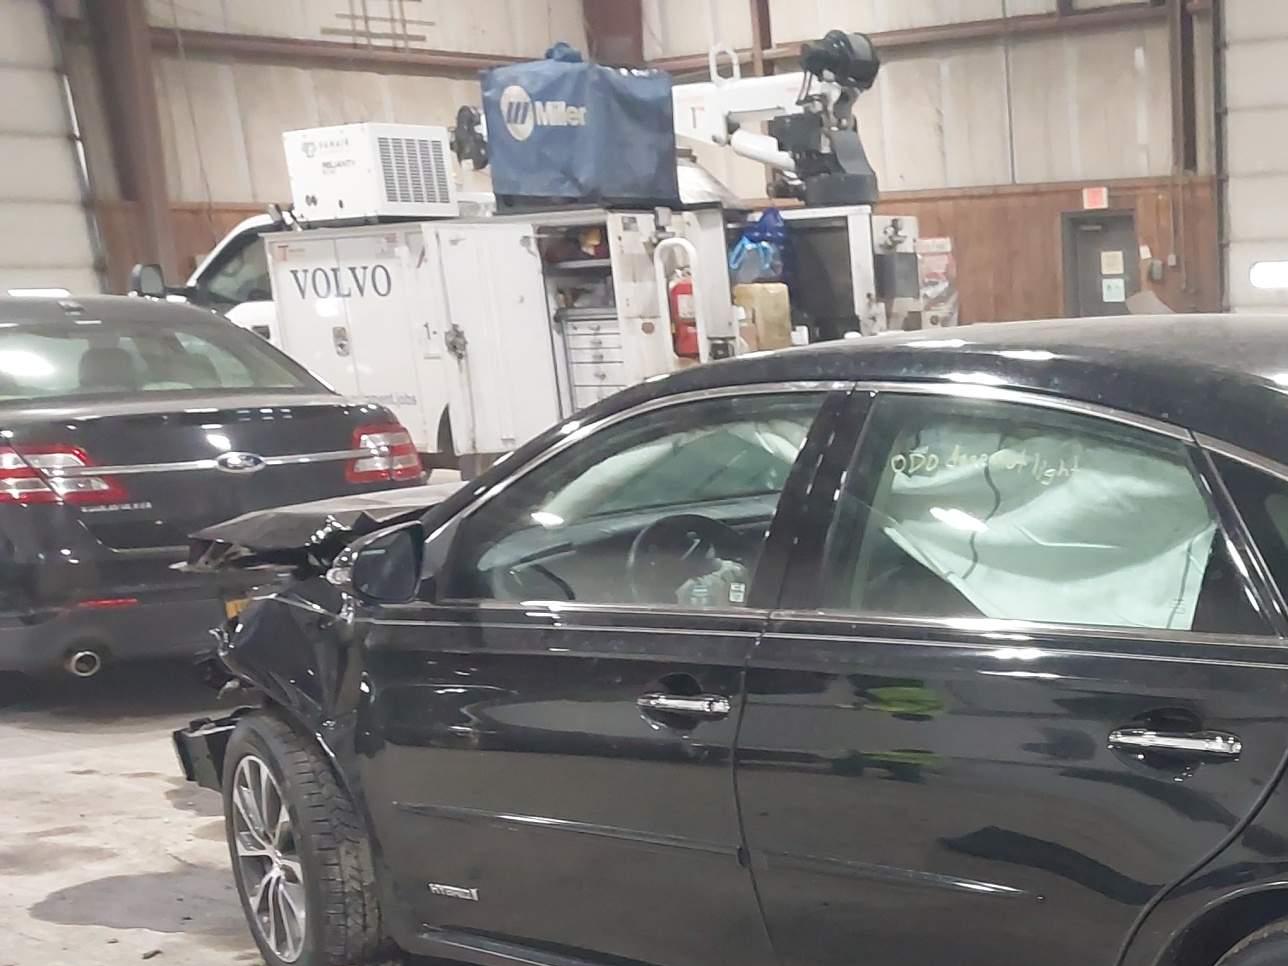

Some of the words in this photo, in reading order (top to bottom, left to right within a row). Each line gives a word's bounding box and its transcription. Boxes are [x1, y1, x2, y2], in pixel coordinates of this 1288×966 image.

[535, 101, 586, 126] Miller
[290, 264, 392, 299] VOLVO
[891, 453, 939, 474] ODO
